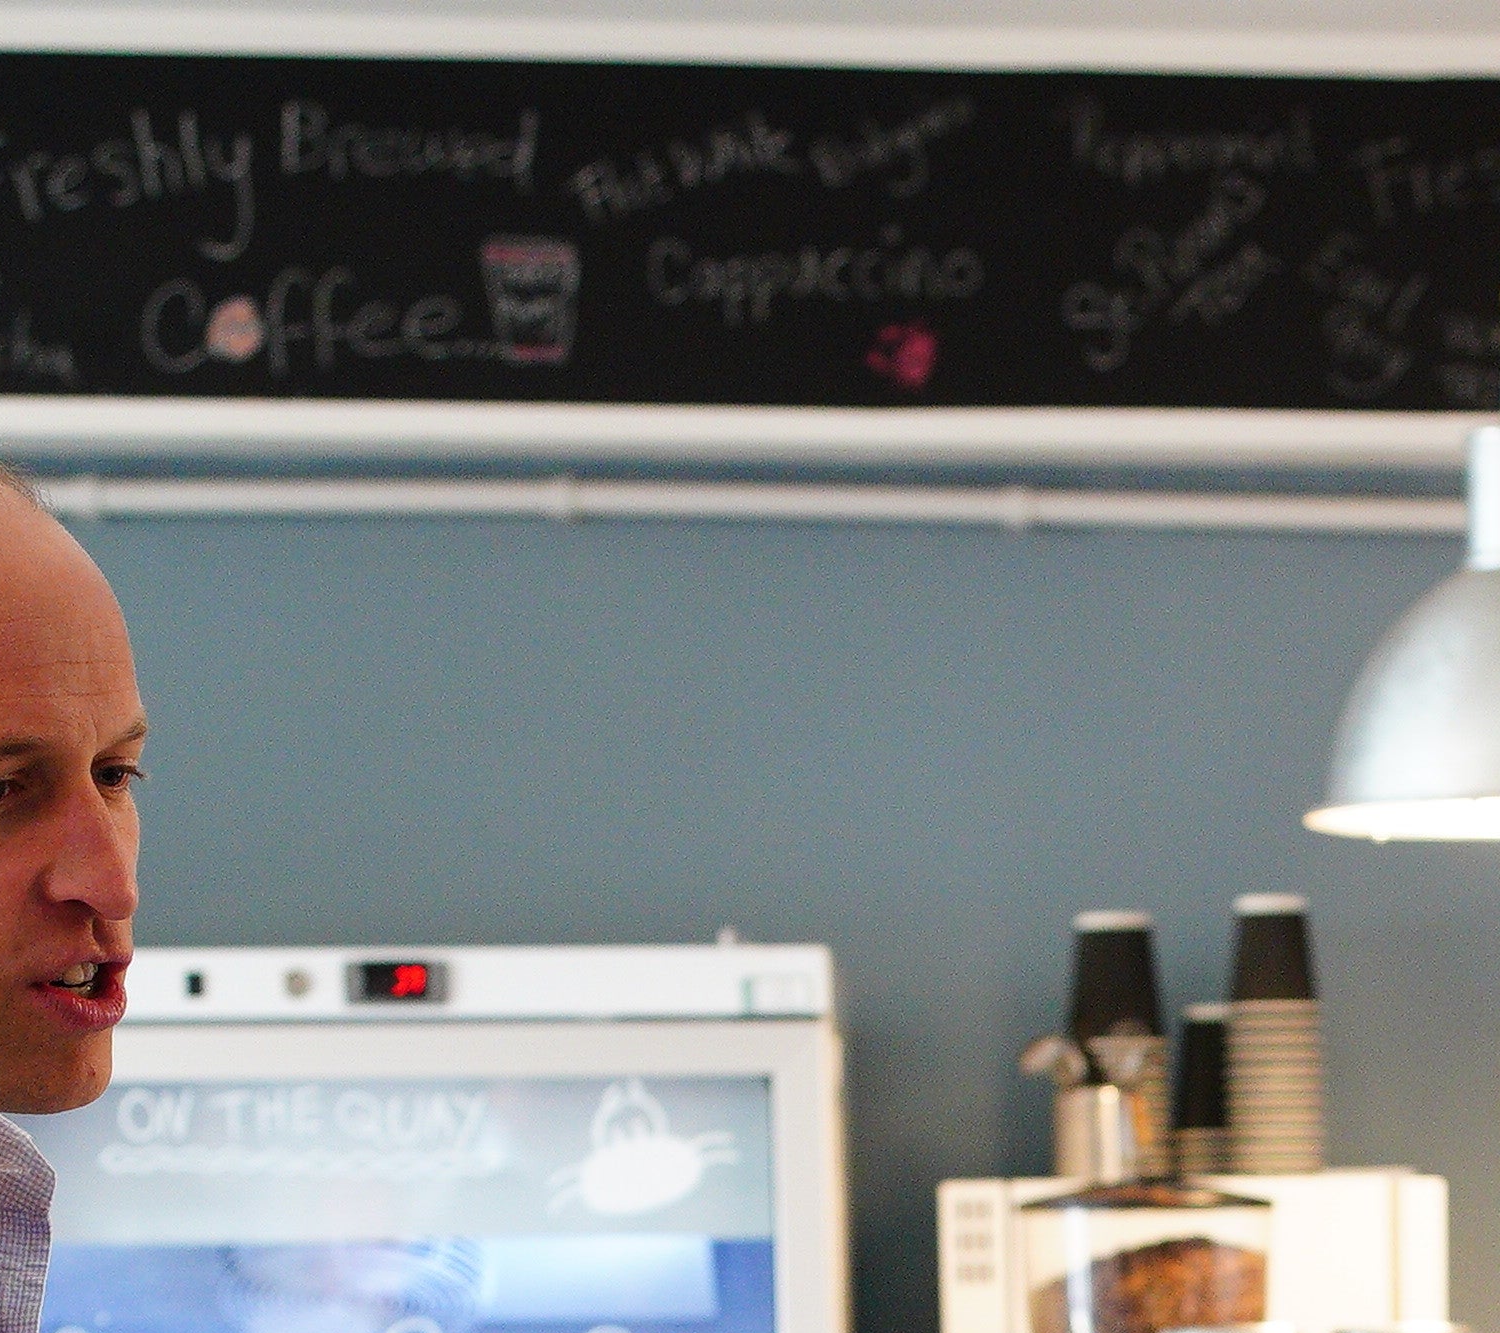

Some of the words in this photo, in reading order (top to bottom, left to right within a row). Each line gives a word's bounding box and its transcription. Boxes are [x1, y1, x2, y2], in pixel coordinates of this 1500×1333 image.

[282, 99, 536, 191] Brewed
[116, 1087, 193, 1145] ON
[212, 1086, 323, 1141] THE
[334, 1088, 488, 1150] QUAY
